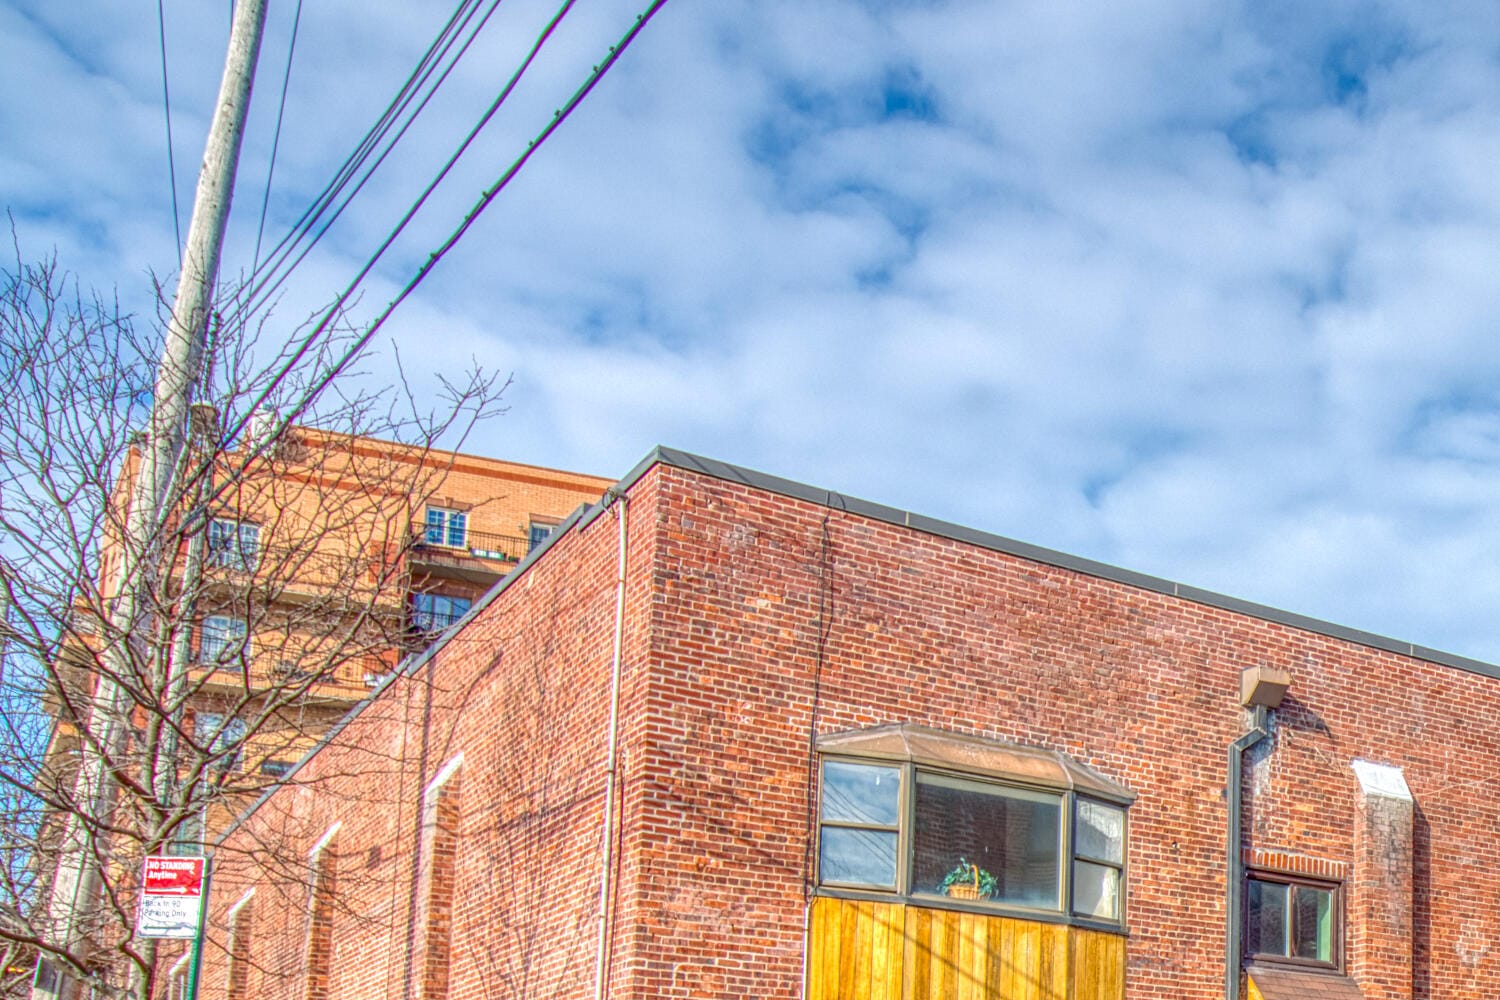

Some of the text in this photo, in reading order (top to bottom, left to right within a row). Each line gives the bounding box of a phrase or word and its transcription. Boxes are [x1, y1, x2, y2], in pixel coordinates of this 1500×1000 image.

[149, 861, 195, 870] NO STANDING
[148, 871, 177, 880] Anytime
